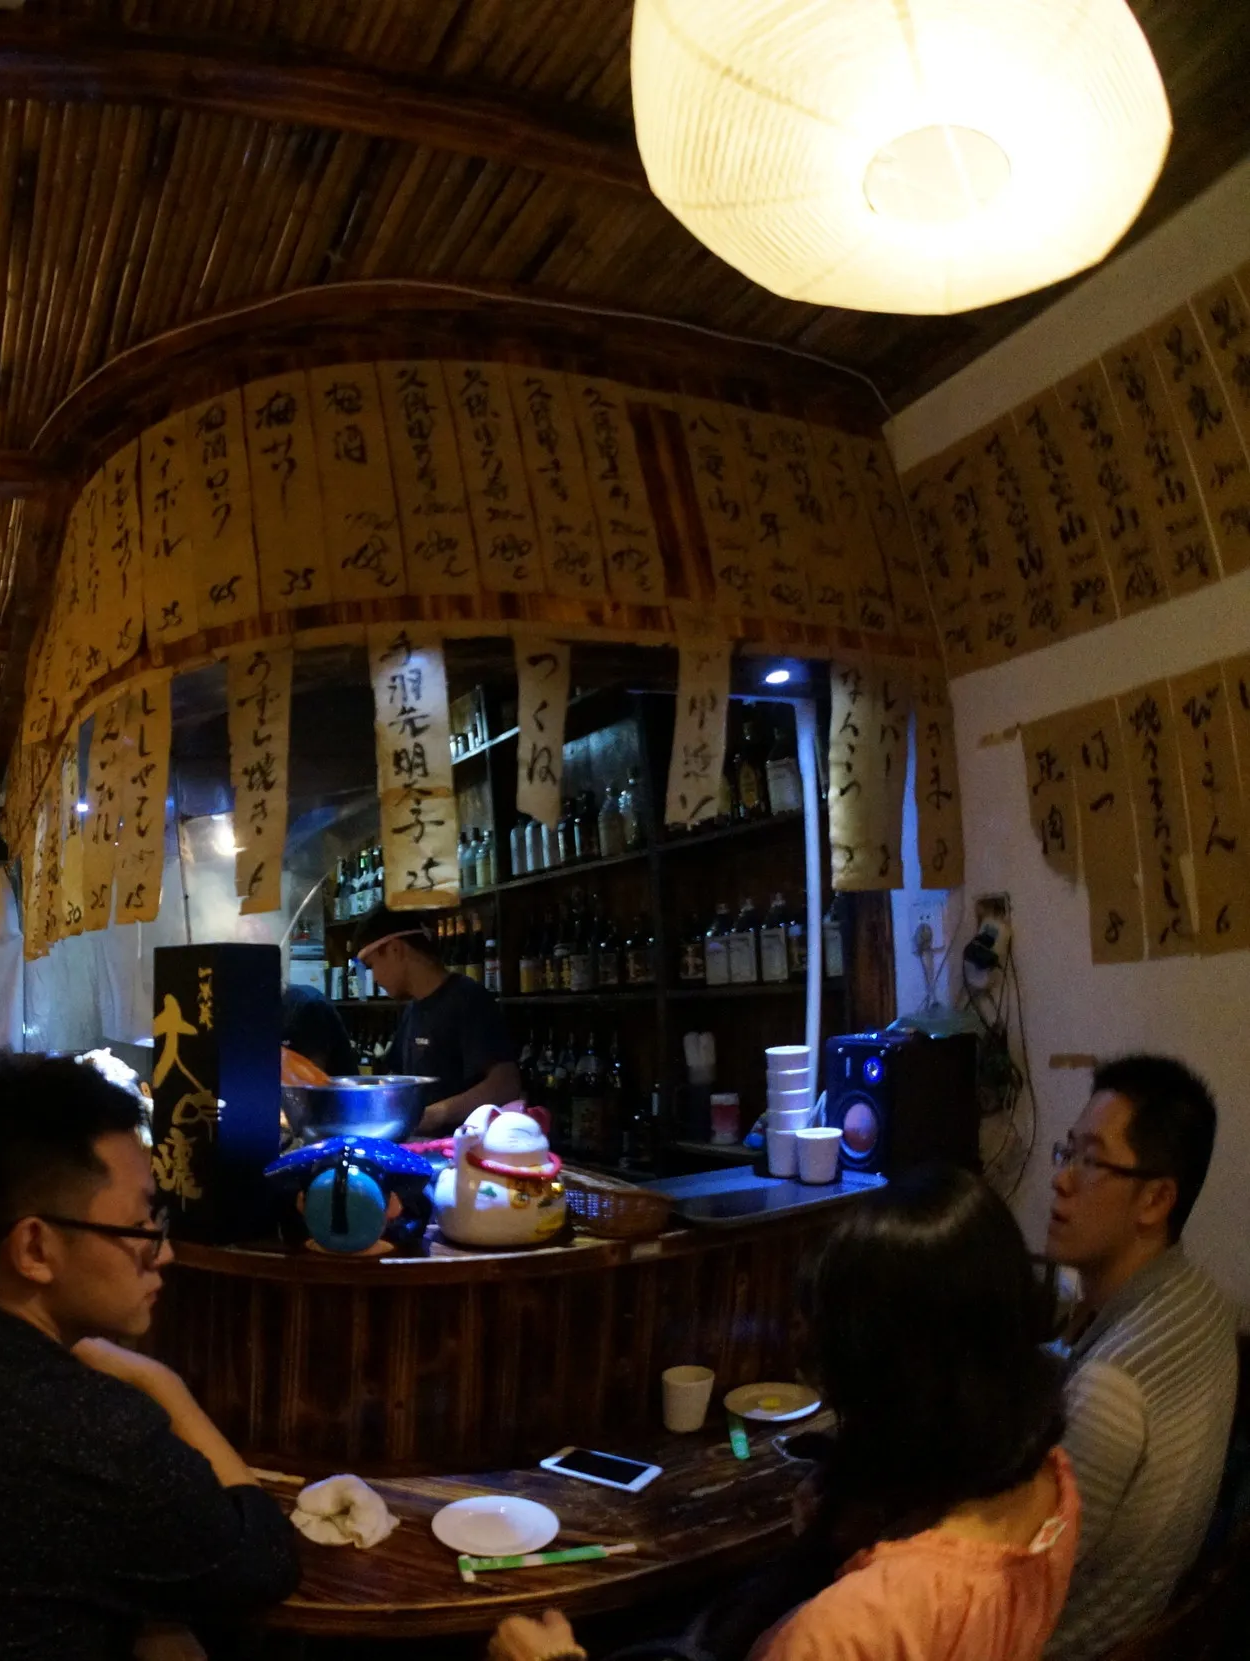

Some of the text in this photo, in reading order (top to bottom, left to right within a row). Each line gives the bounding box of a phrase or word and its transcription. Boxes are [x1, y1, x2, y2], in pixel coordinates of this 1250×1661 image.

[150, 435, 186, 558] ハイボール
[525, 652, 561, 786] つくね
[406, 856, 441, 891] 25
